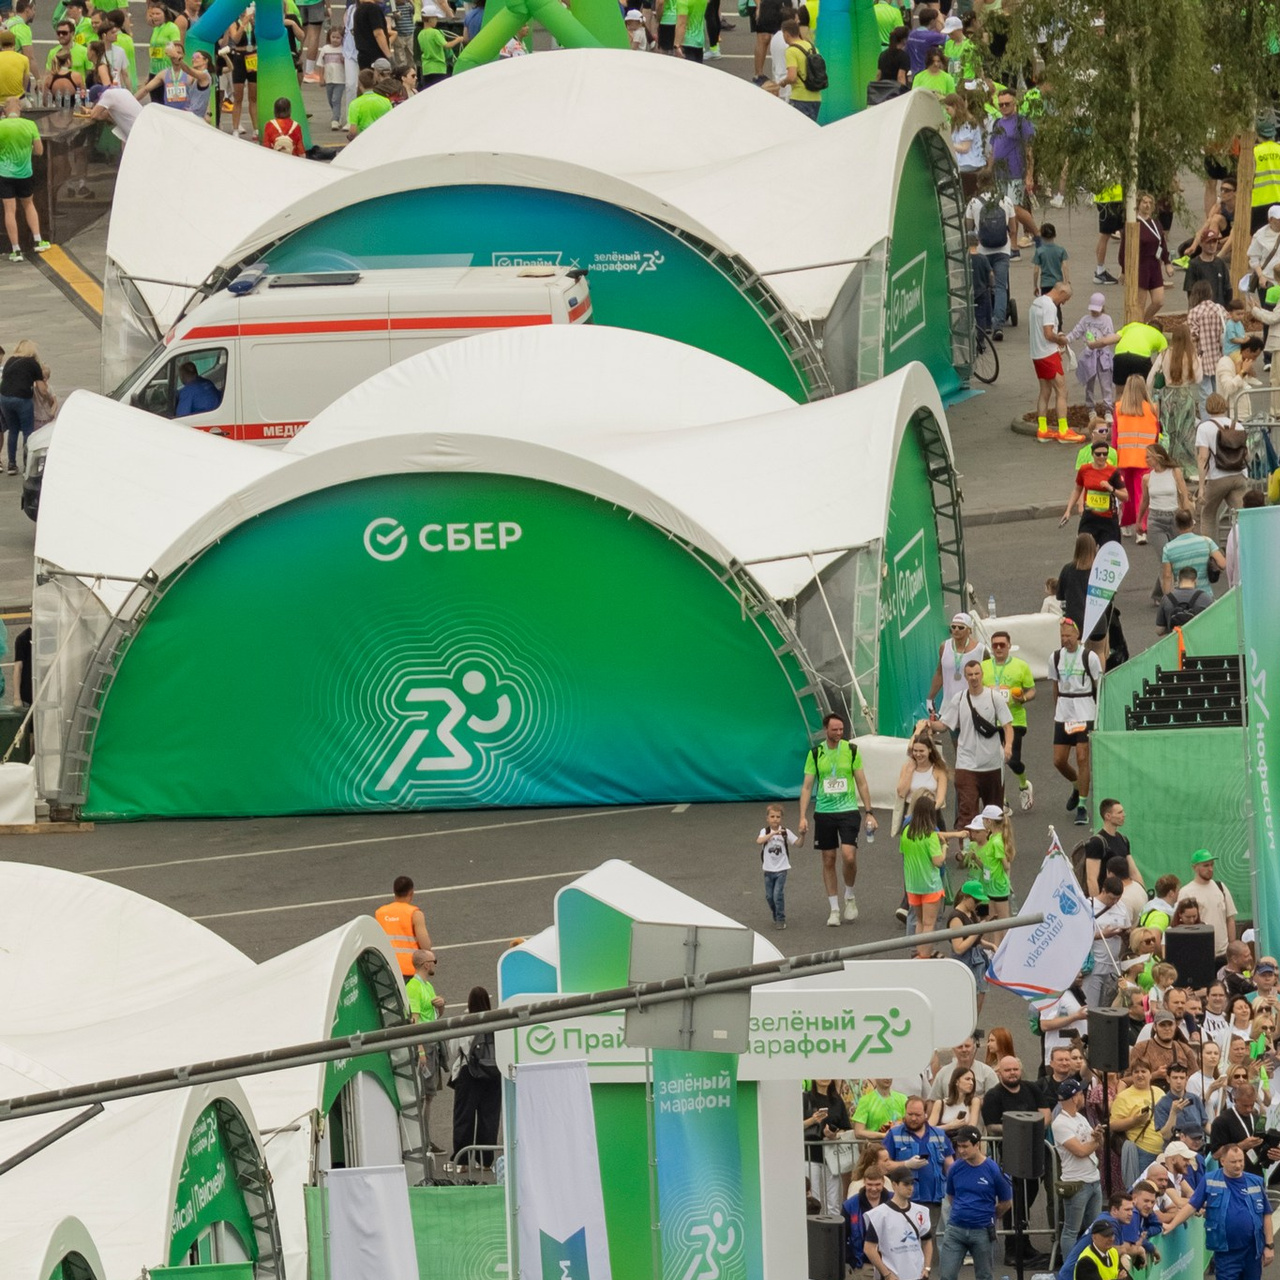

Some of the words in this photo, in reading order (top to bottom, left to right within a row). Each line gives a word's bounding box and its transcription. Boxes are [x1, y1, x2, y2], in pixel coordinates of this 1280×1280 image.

[588, 262, 637, 273] марафон
[593, 252, 641, 262] зелёный
[418, 521, 523, 553] СБЕР
[749, 1006, 856, 1032] зелёный
[659, 1070, 731, 1094] зелёный
[659, 1093, 731, 1114] марафон
